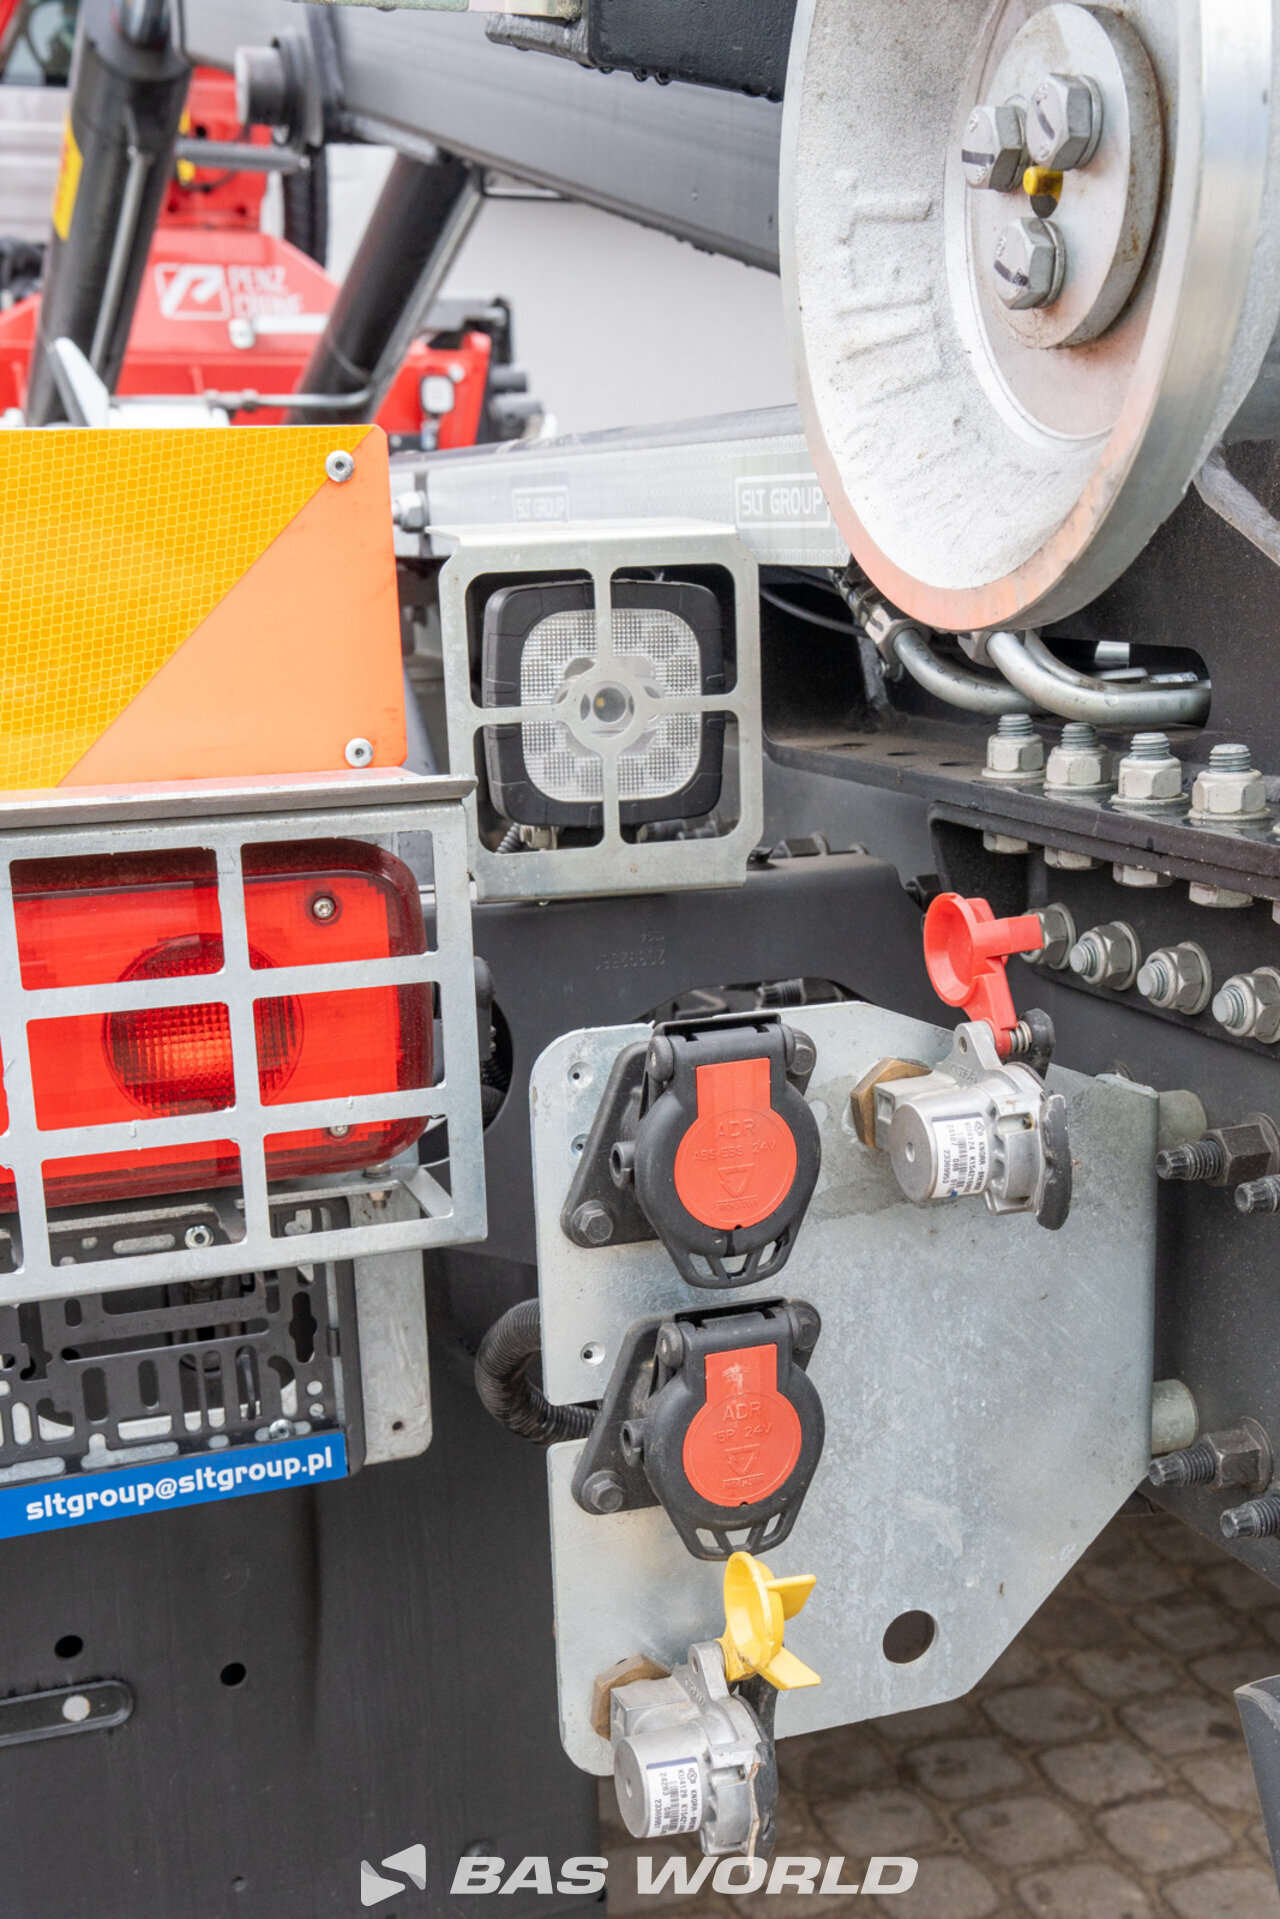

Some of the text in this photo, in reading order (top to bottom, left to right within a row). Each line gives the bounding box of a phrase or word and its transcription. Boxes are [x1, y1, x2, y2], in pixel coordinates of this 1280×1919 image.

[516, 496, 565, 519] SLT GROUP
[741, 486, 824, 516] SLT GROUP
[717, 1119, 755, 1139] ADR
[752, 1138, 777, 1154] 24V
[723, 1401, 762, 1421] ADR
[713, 1421, 773, 1442] 15P 24V
[26, 1446, 333, 1521] sltgroup@sltgroup.pl
